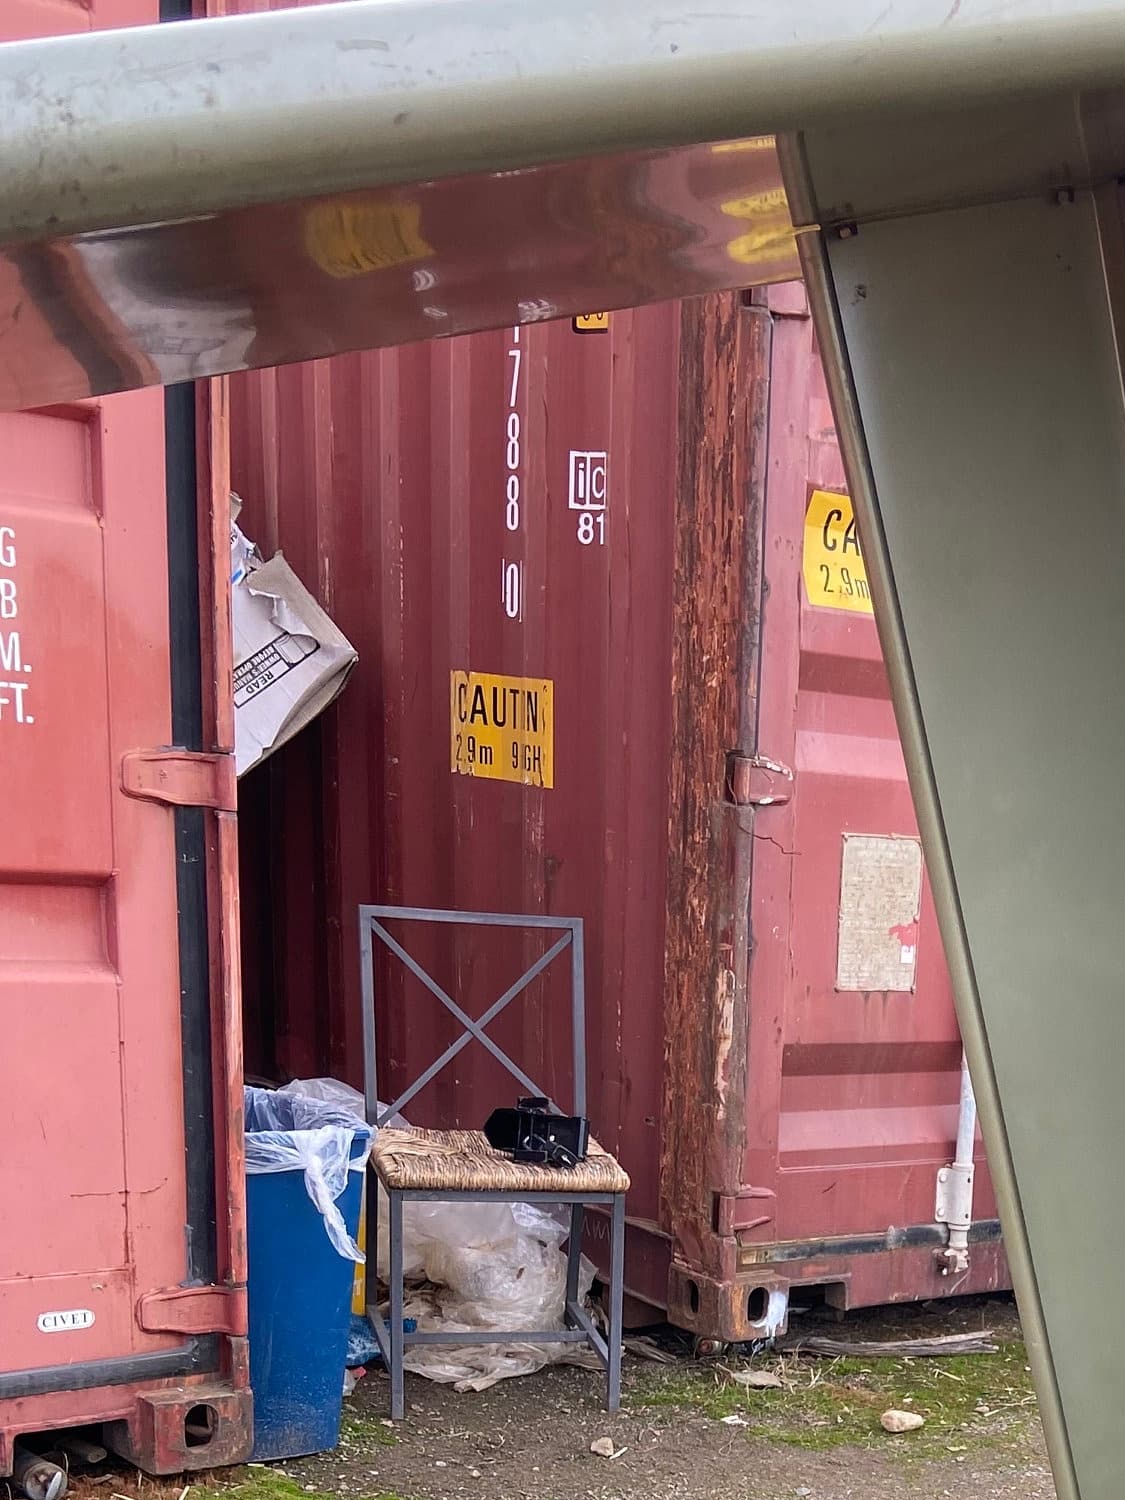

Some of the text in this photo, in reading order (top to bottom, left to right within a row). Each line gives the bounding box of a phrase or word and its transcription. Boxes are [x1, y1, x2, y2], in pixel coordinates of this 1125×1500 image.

[577, 512, 605, 545] 81
[244, 670, 274, 694] READ
[42, 1312, 90, 1328] CIVET
